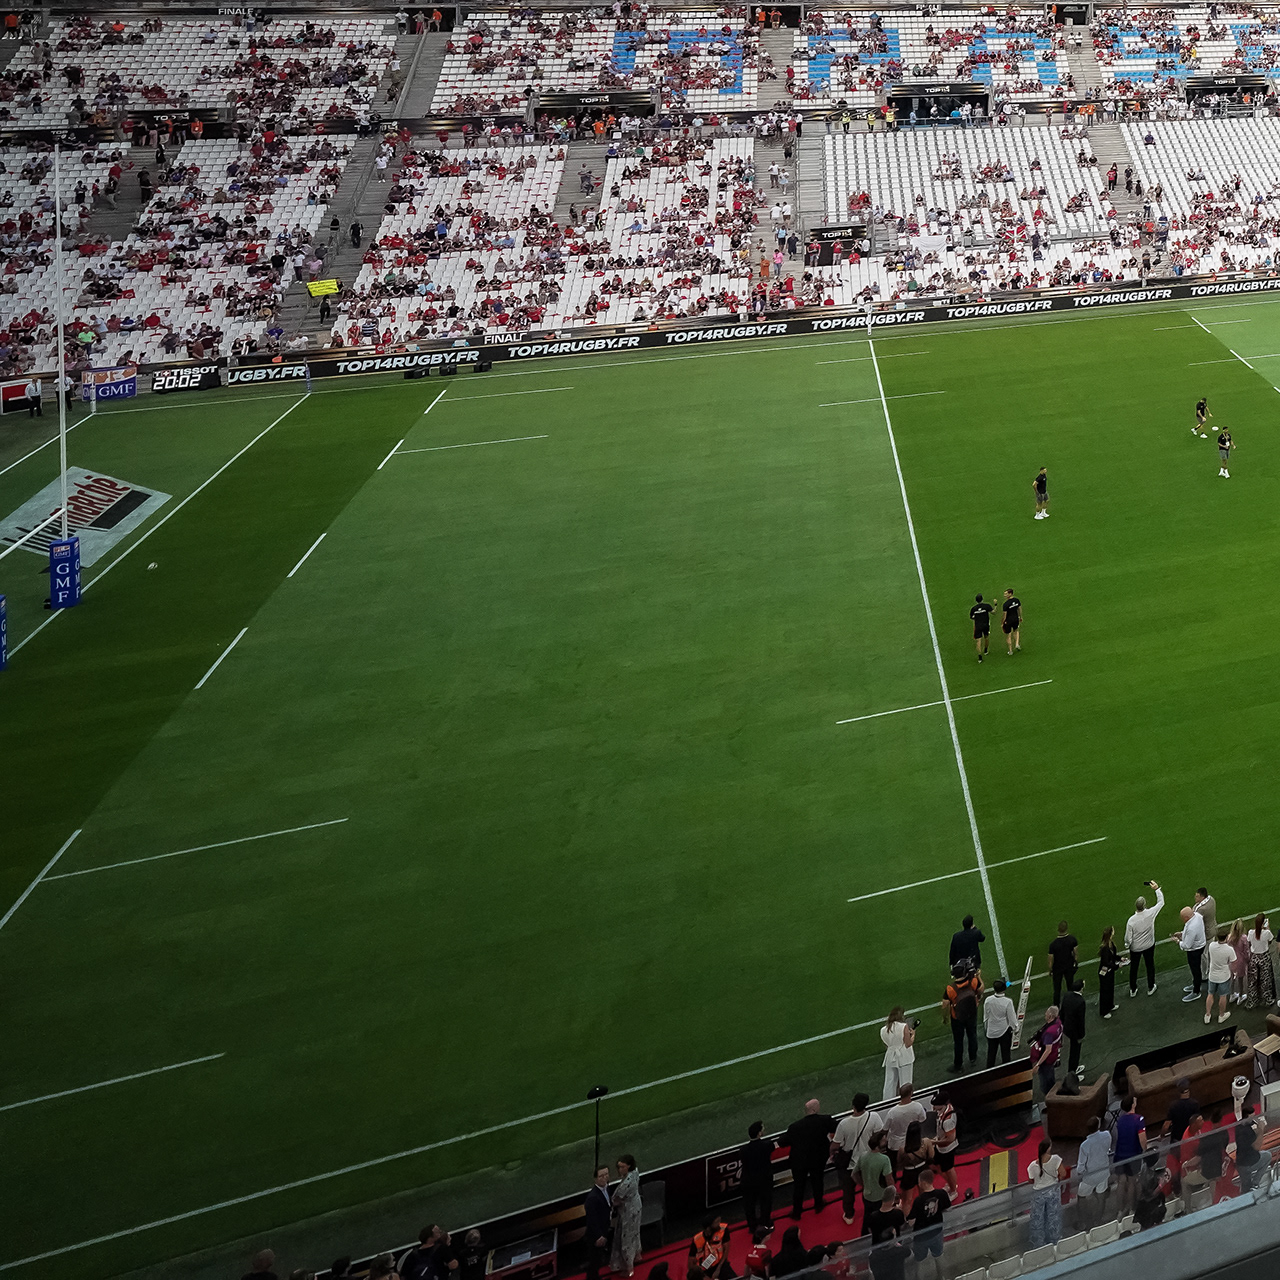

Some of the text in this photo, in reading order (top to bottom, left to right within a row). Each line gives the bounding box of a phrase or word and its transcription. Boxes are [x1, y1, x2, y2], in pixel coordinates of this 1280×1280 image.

[1073, 288, 1172, 307] TOP14RUGBY.FR
[946, 300, 1053, 319] TOP14RUGBY.FR
[811, 310, 925, 331] TOP14RUGBY.FR
[665, 323, 788, 344] TOP14RUGBY.FR
[508, 336, 640, 358] TOP14RUGBY.FR
[171, 366, 218, 376] TISSOT
[336, 350, 480, 373] TOP14RUGBY.FR
[99, 383, 133, 398] GMF
[153, 375, 201, 391] 20:02
